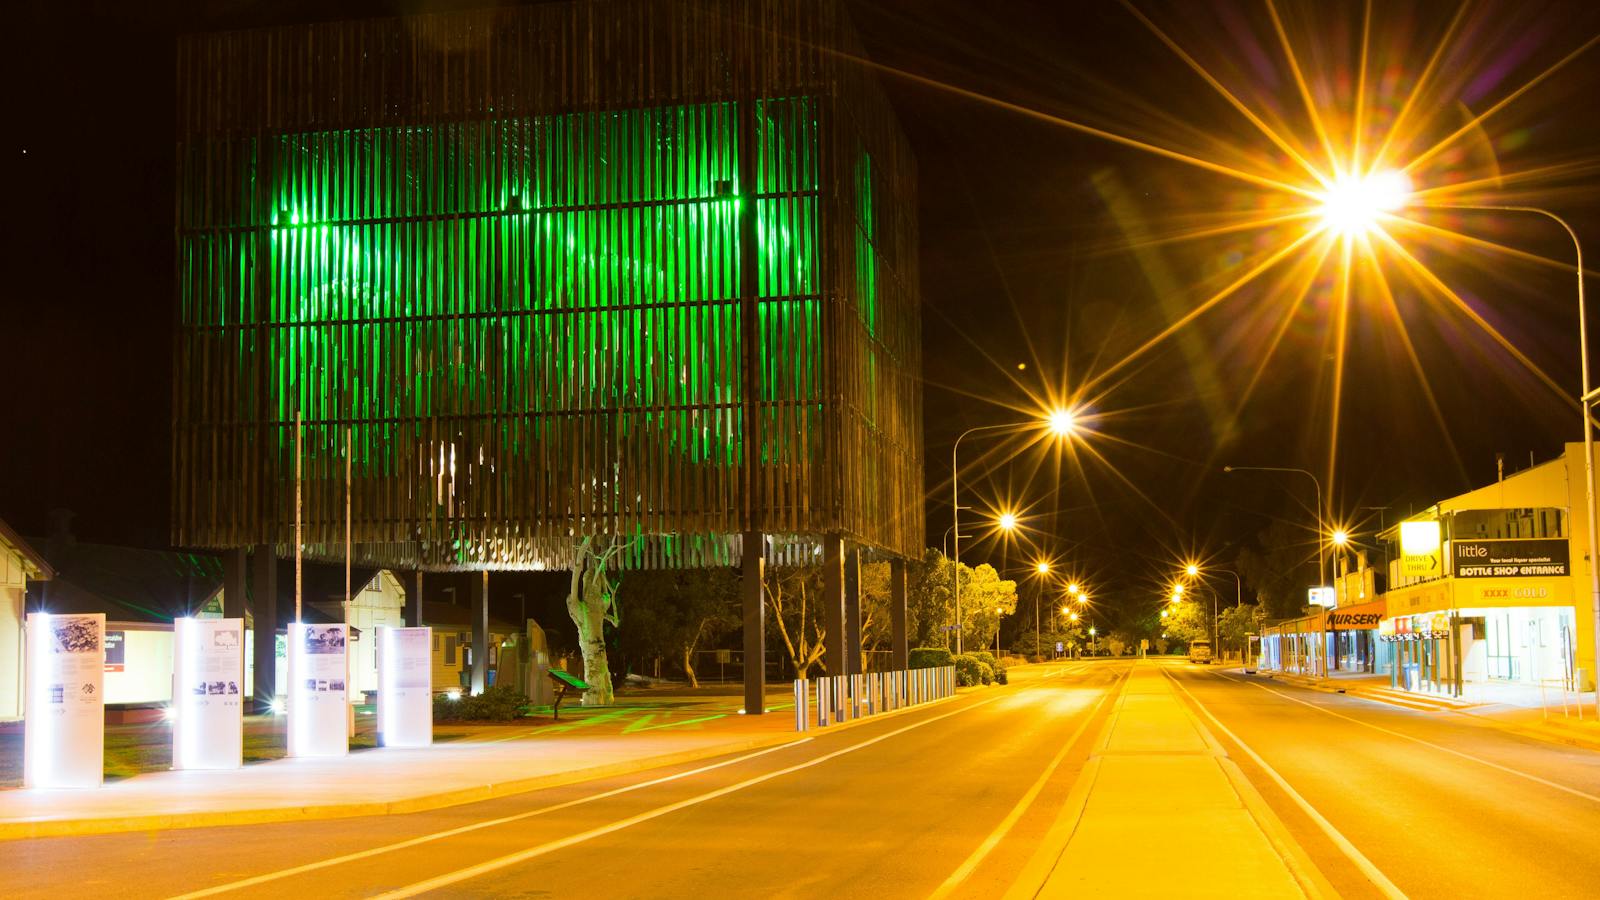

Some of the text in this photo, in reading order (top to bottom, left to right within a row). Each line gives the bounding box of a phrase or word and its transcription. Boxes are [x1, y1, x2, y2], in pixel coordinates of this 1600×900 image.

[1458, 544, 1488, 558] little
[1405, 554, 1428, 562] DRIVE
[1407, 563, 1428, 571] THRU
[1460, 565, 1565, 576] BOTTLE SHOP ENTRANCE
[1483, 587, 1547, 599] XXXX GOLD
[1327, 613, 1383, 625] NURSERY
